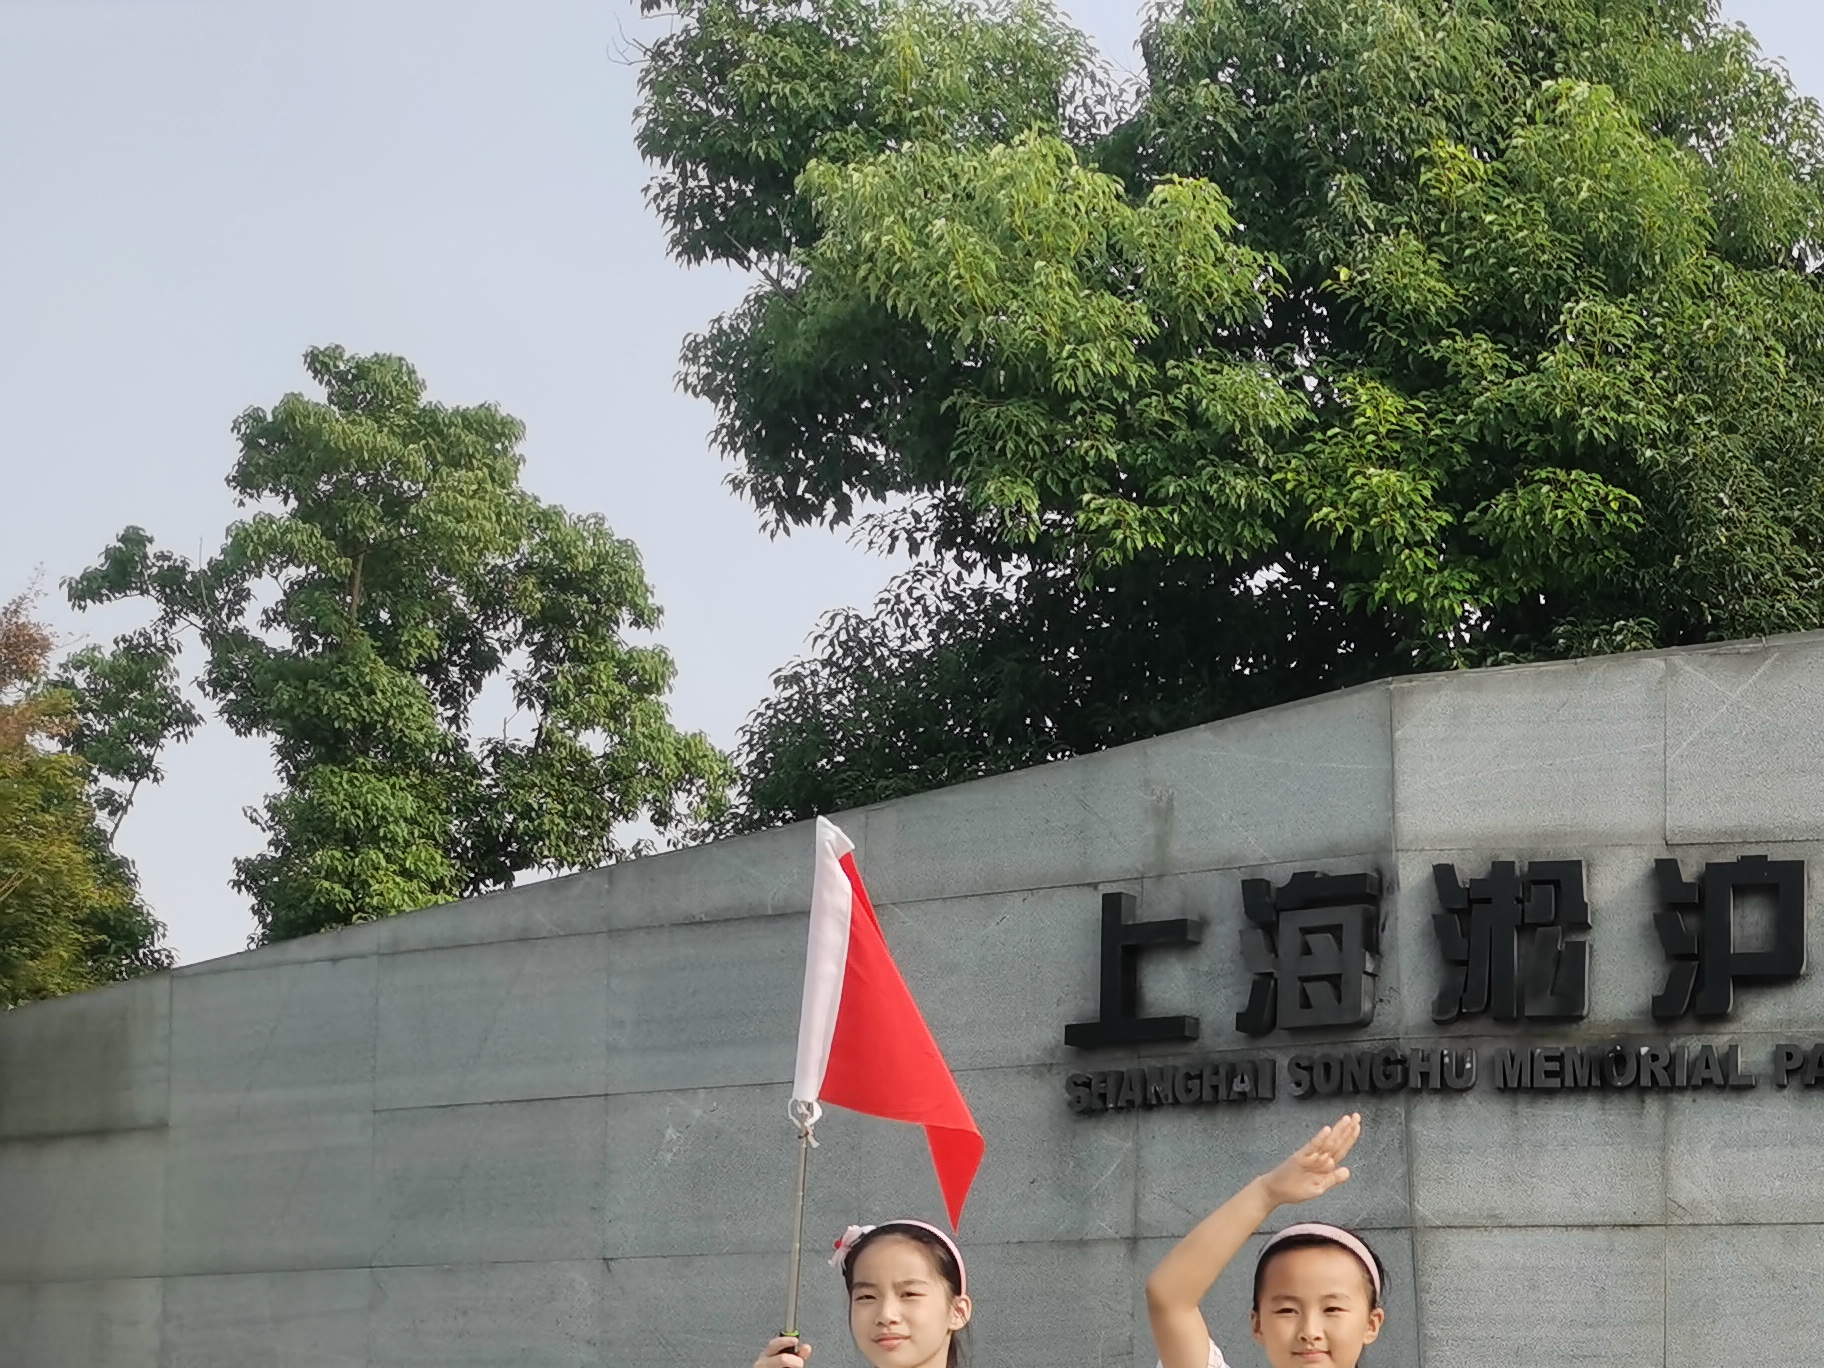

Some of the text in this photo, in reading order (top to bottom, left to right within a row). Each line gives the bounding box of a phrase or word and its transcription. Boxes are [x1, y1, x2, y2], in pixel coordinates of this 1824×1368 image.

[1064, 1056, 1278, 1110] SHANGHAI
[1287, 1047, 1478, 1094] SONGHU
[1493, 1044, 1756, 1090] MEMORIAL
